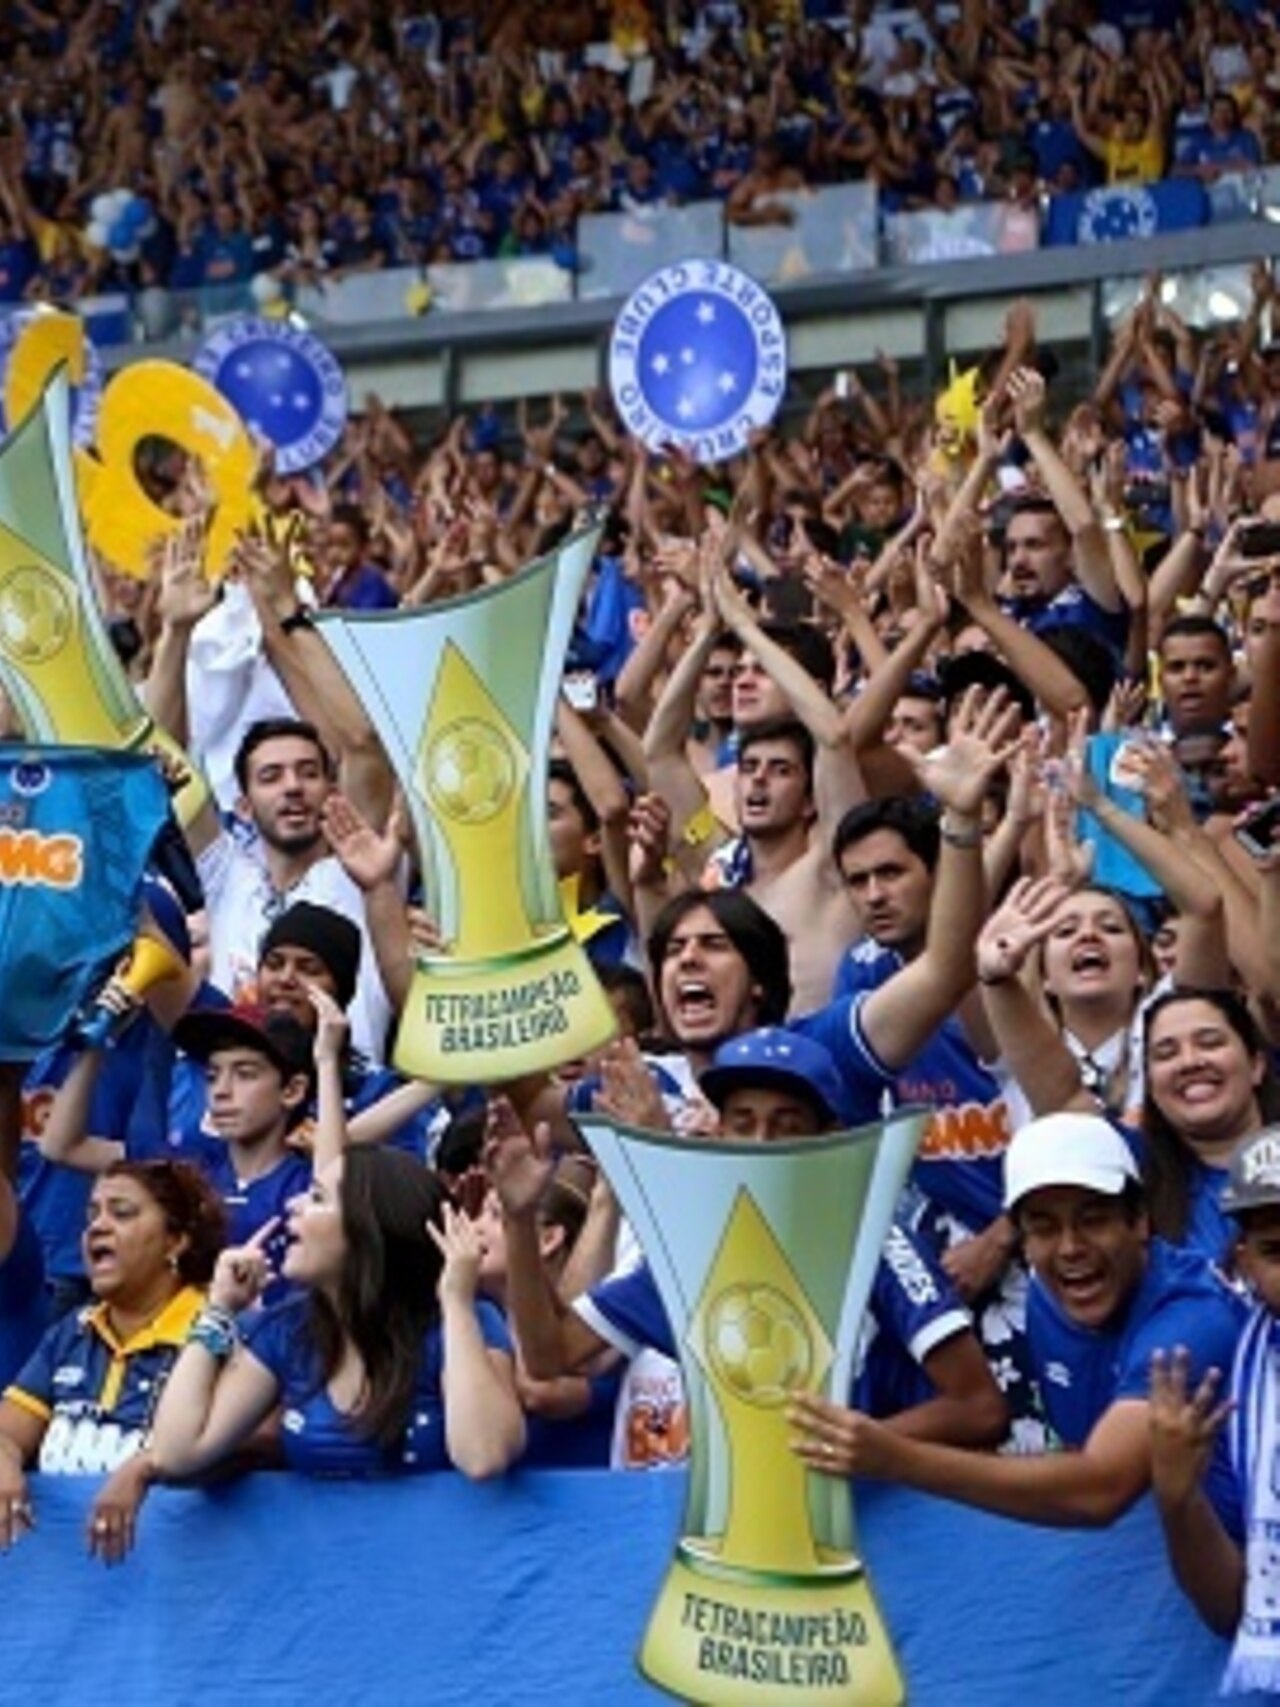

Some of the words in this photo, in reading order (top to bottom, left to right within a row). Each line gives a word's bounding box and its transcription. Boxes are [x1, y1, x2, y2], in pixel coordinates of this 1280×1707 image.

[615, 266, 688, 358] CLUBE
[426, 970, 582, 1024] TETRACAMPEÃO
[440, 1004, 569, 1054] BRASILEIRO
[681, 1592, 869, 1647] TETRACAMPEÃO
[697, 1636, 851, 1687] BRASILEIRO
